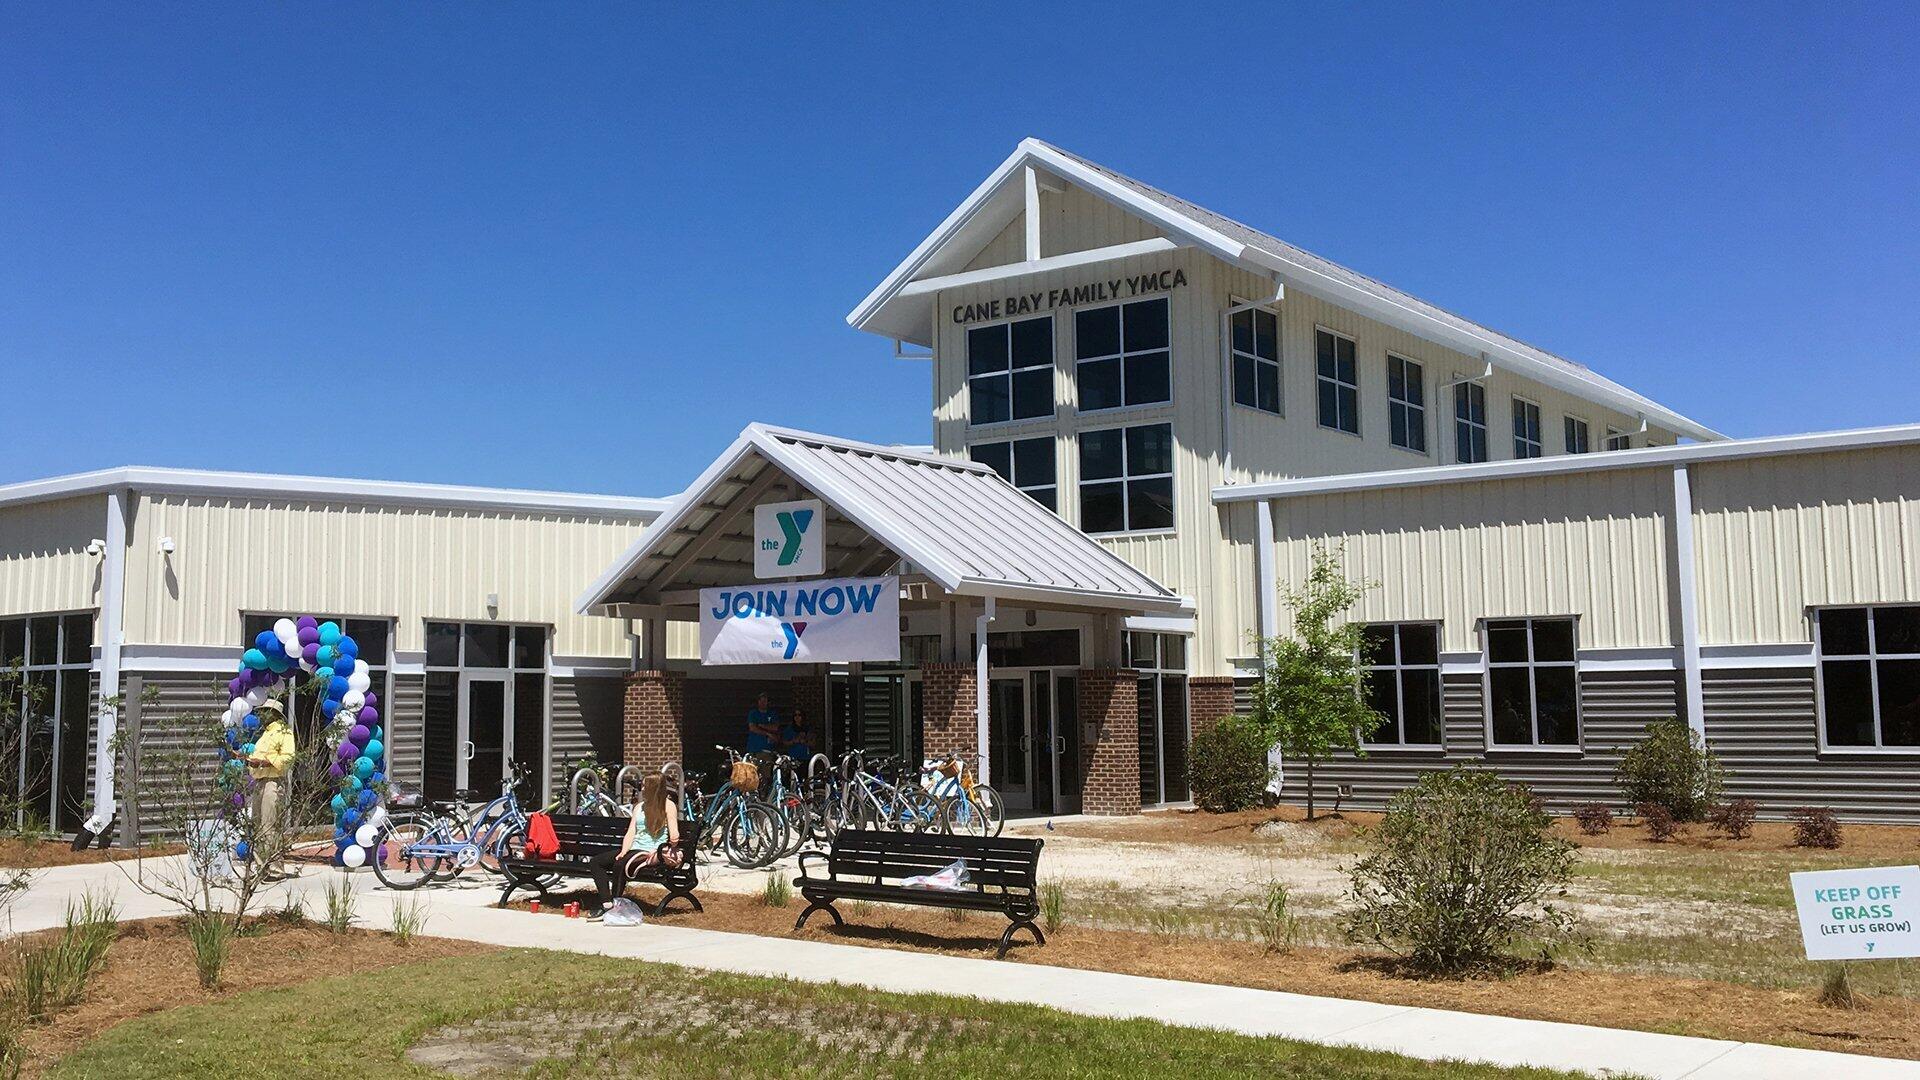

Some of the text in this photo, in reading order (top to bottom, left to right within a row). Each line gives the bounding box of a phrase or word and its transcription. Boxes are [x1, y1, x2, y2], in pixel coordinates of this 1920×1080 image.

[953, 268, 1187, 324] CANE BAY FAMILY YMCA
[761, 510, 814, 566] the Y
[712, 584, 882, 620] JOIN NOW
[771, 640, 783, 648] the
[1815, 885, 1901, 903] KEEP OFF
[1832, 904, 1893, 920] GRASS
[1820, 921, 1911, 936] (LET US GROW)
